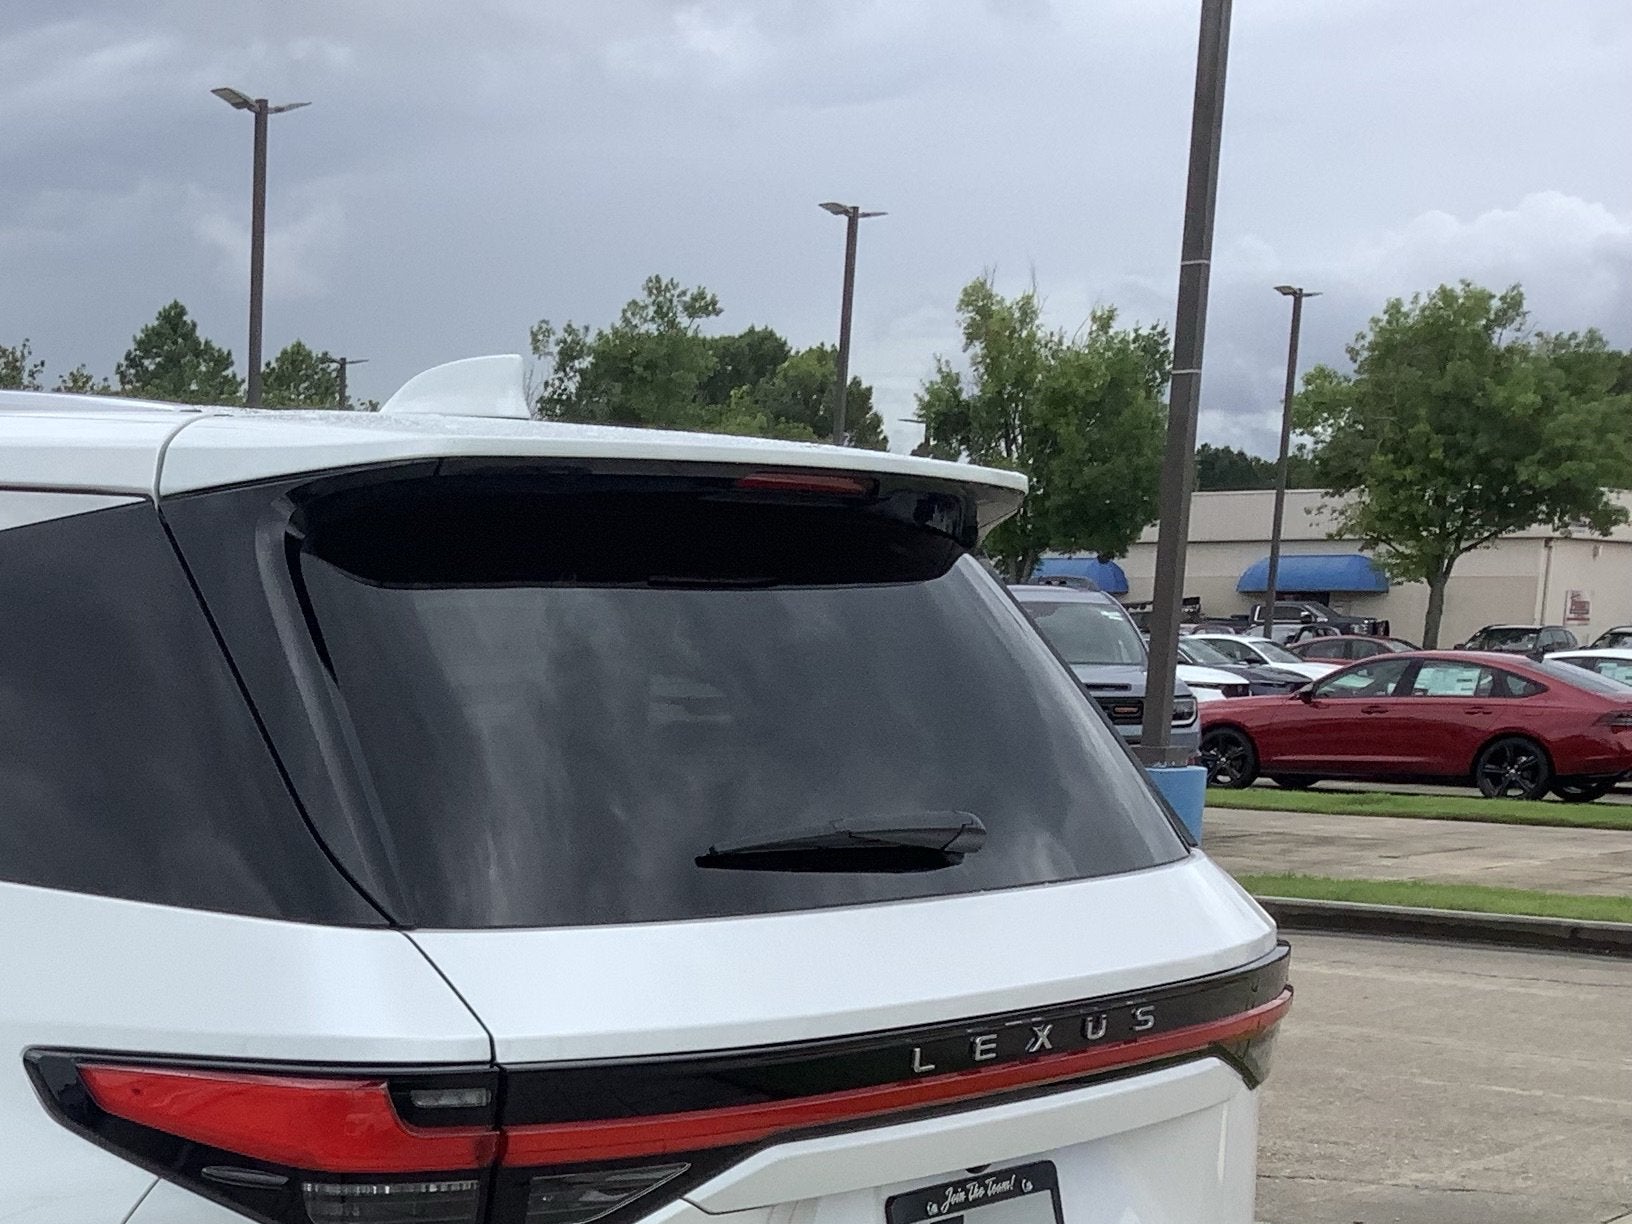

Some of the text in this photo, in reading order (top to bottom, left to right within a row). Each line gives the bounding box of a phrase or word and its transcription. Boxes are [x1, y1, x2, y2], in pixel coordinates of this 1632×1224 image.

[912, 1004, 1156, 1073] LEXUS
[940, 1174, 1016, 1213] Join The Team!
